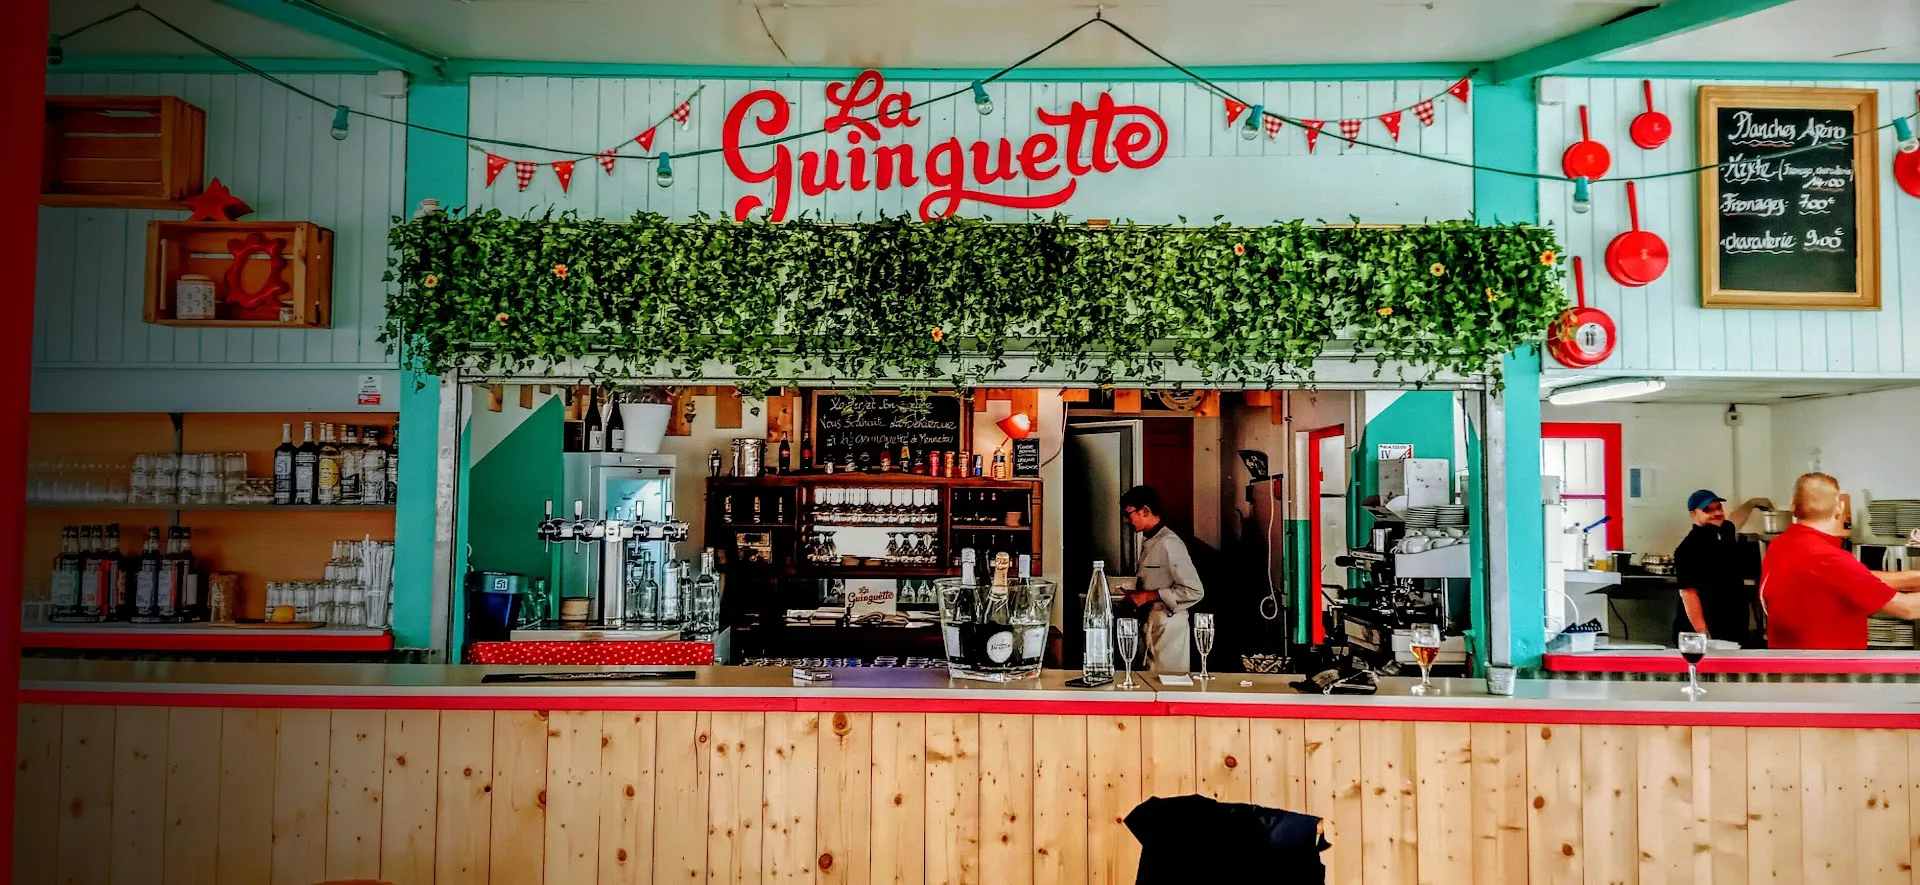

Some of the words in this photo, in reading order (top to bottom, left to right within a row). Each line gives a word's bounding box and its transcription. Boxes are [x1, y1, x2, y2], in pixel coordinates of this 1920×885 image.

[825, 70, 921, 141] La
[1728, 111, 1796, 141] Planches
[1797, 117, 1847, 146] Apéro
[722, 92, 1168, 222] Guinguette
[276, 461, 288, 473] 51
[496, 579, 506, 589] 51
[848, 591, 894, 608] Guinguette
